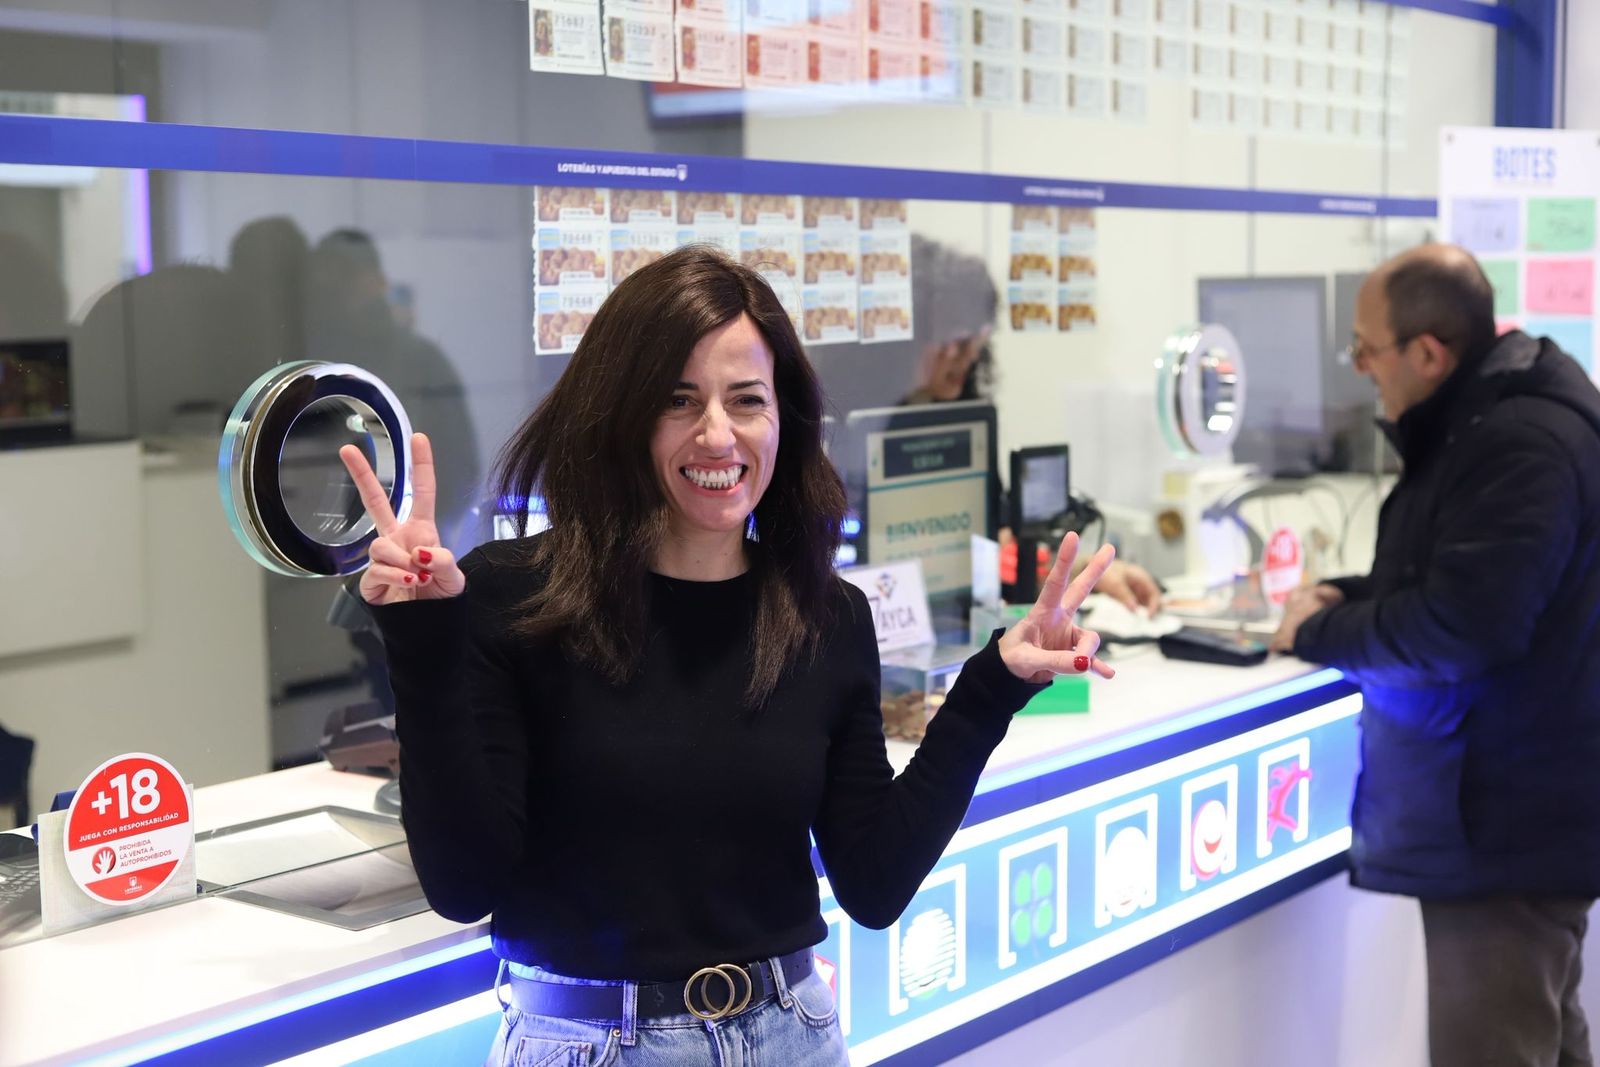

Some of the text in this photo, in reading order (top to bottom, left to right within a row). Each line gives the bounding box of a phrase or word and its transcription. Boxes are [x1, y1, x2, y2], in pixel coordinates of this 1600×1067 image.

[558, 162, 596, 174] LOTERÍAS
[596, 165, 602, 174] Y
[602, 165, 636, 176] APUESTAS
[1493, 147, 1556, 178] BOTES
[886, 513, 971, 541] BIENVENIDO
[91, 768, 161, 819] +18
[79, 812, 179, 842] JUEGA CON RESPONSABILIDAD
[119, 839, 151, 851] PROHIBIDA
[129, 848, 148, 857] VENTA
[121, 849, 172, 867] AUTOPROHIBIDOS
